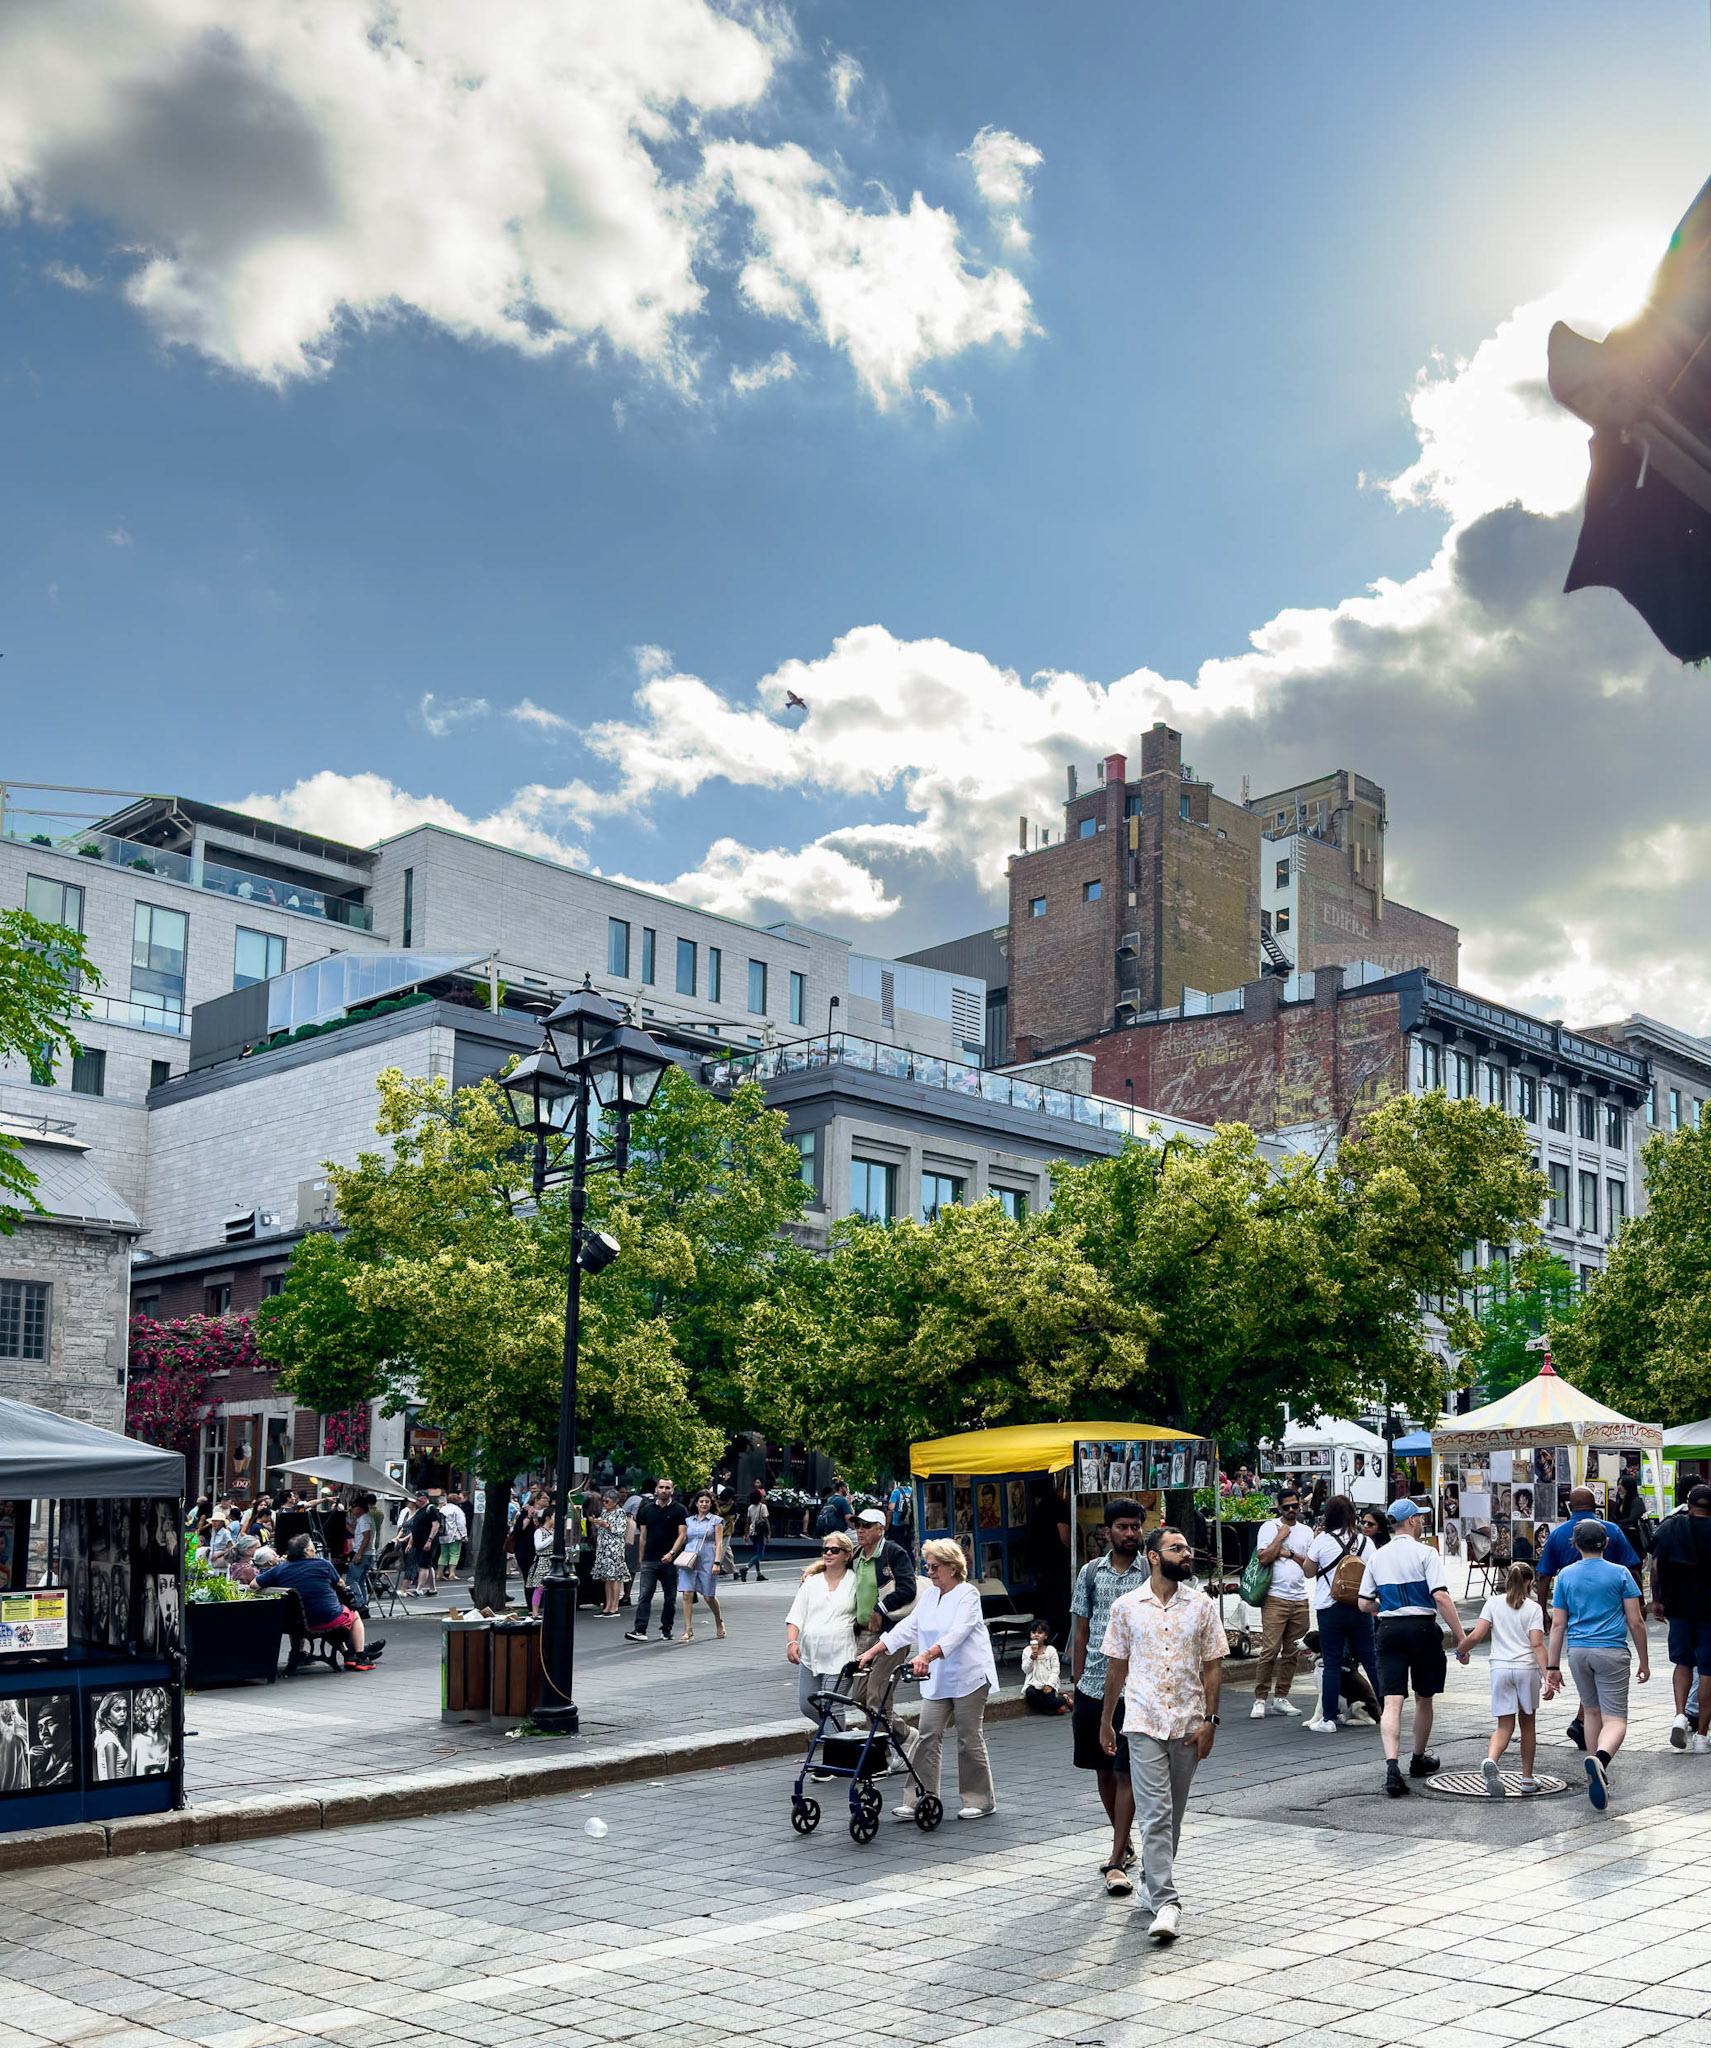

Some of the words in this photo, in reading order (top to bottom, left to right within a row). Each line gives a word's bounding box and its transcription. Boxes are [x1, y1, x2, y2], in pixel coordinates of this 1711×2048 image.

[1432, 1429, 1574, 1447] CARICATURES
[1583, 1423, 1662, 1441] CARICATURES
[235, 1480, 249, 1489] DQ
